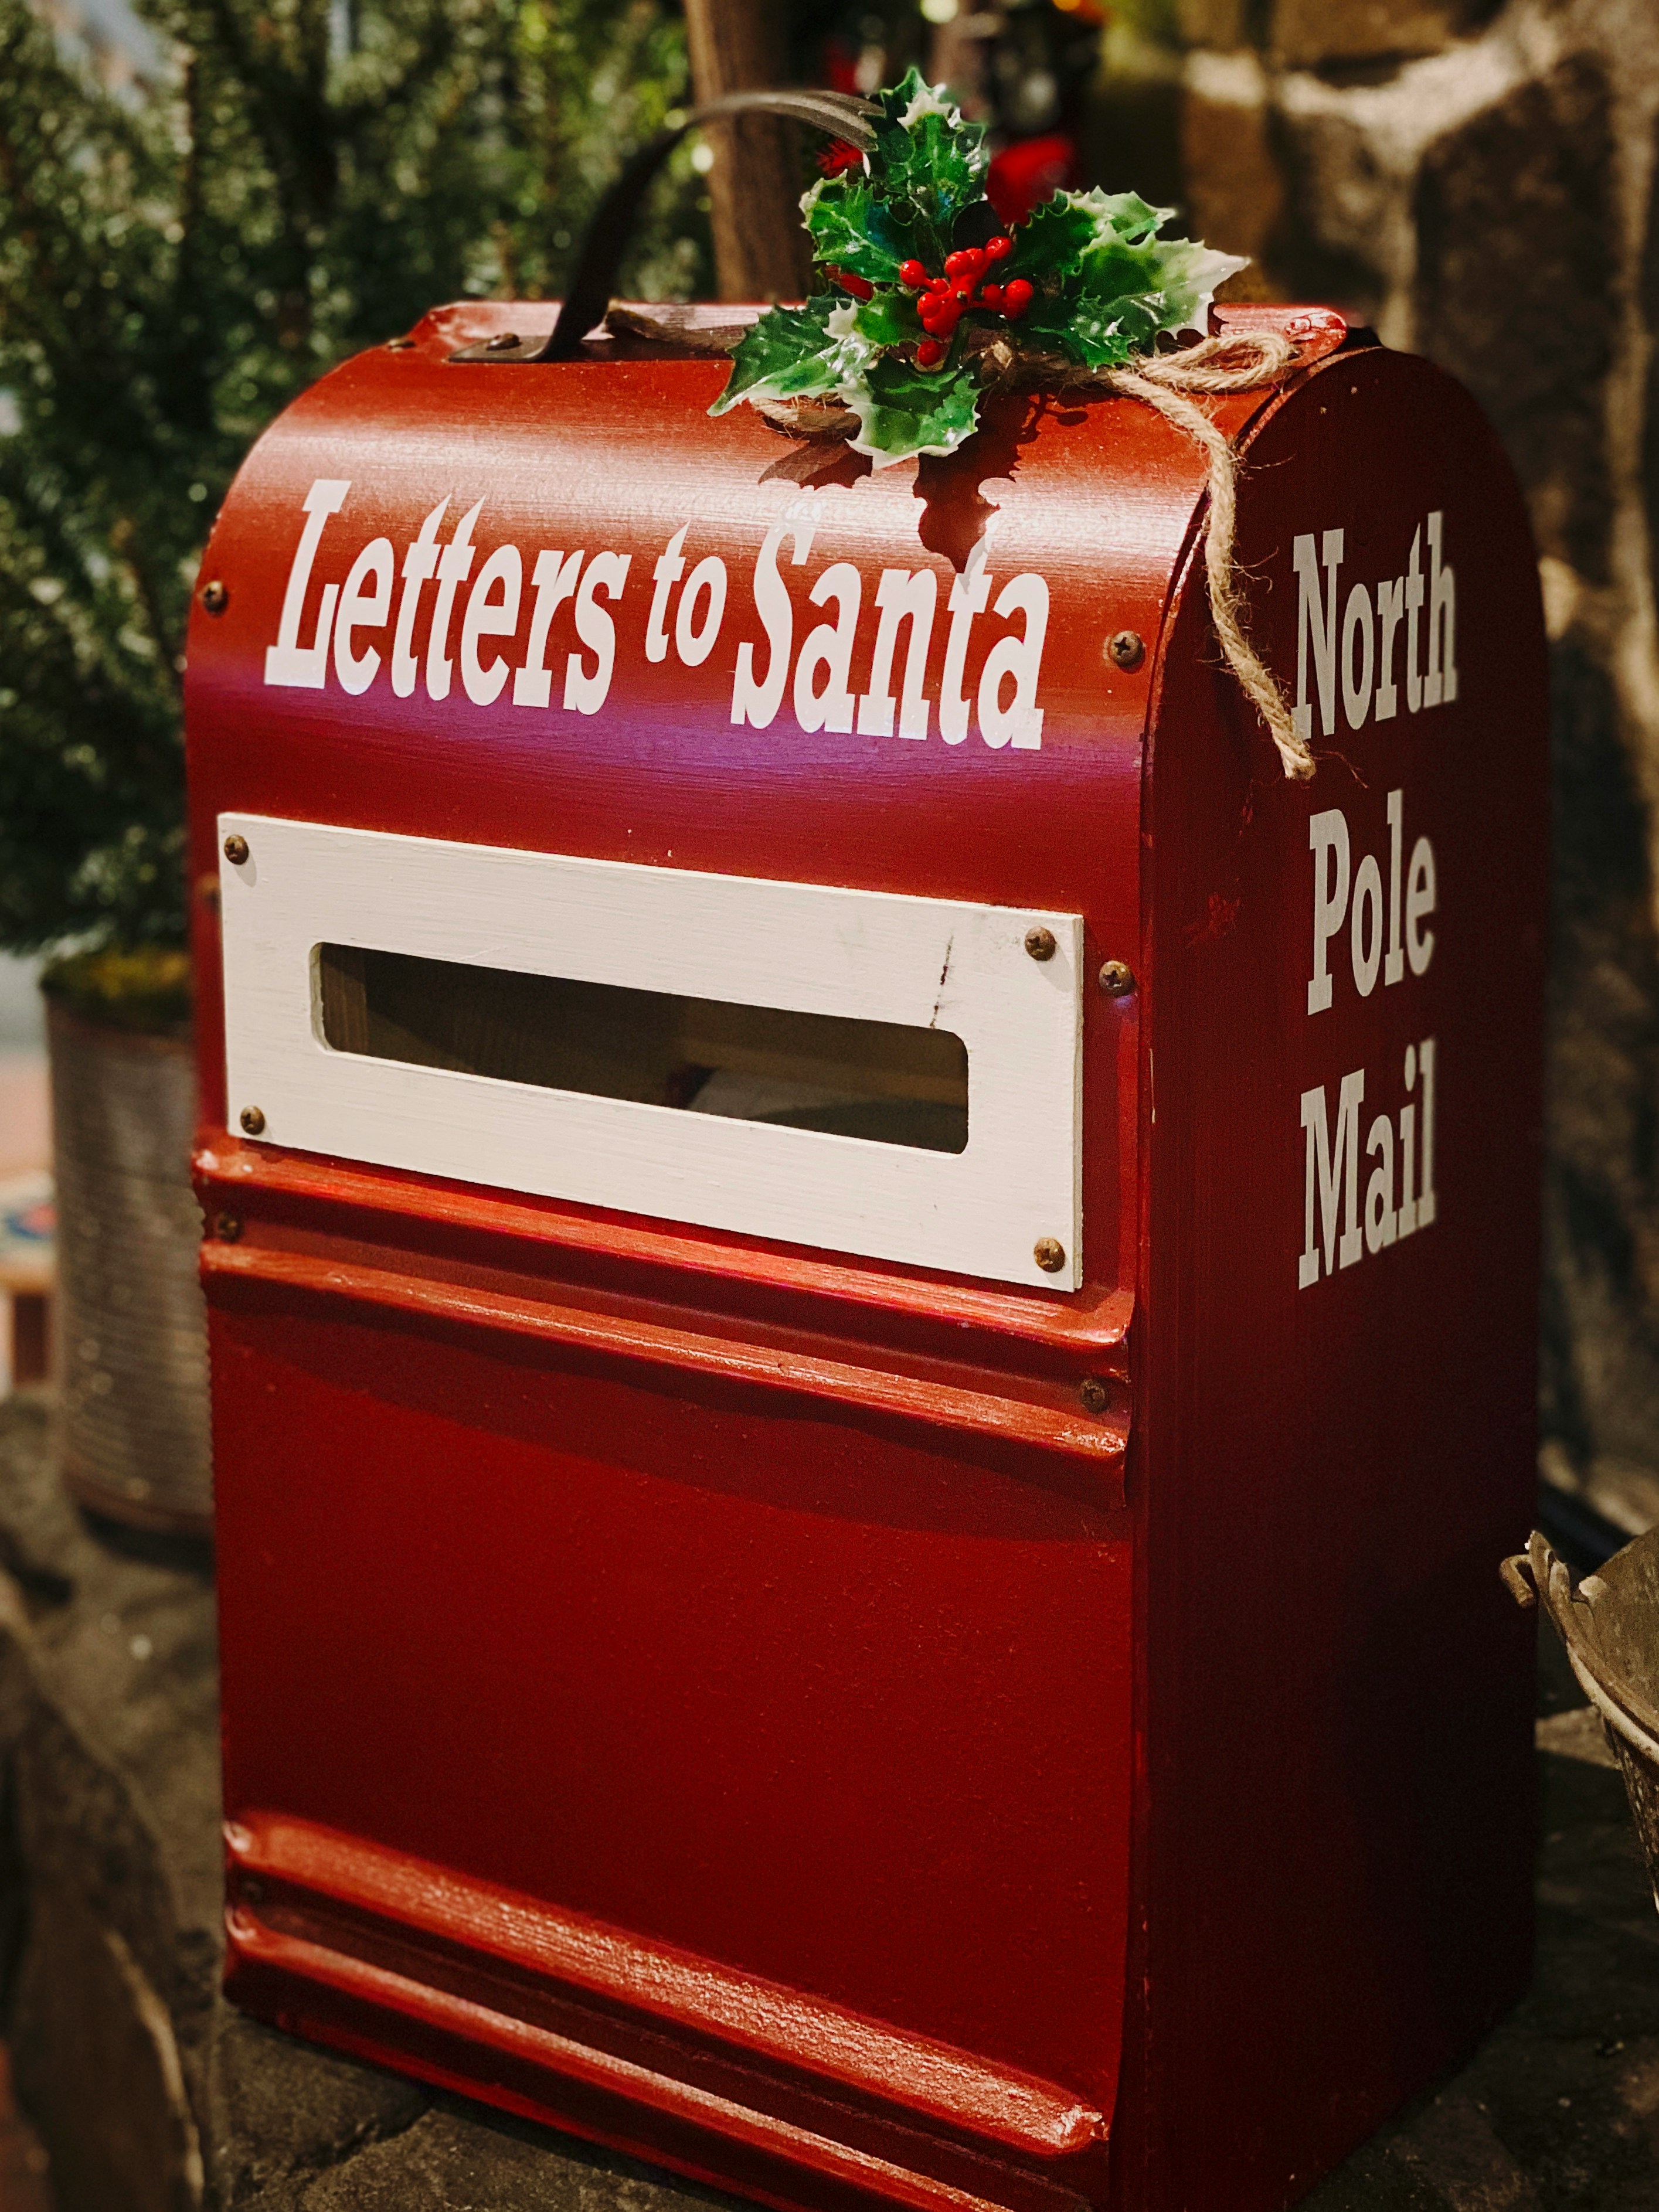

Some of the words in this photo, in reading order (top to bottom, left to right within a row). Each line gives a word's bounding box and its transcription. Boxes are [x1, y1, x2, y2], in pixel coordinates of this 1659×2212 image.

[264, 479, 632, 715] Letters
[644, 520, 728, 668] to
[730, 498, 1051, 751] Santa
[1291, 510, 1459, 741] North
[1307, 789, 1437, 1016] Pole
[1297, 1038, 1437, 1291] Mail
